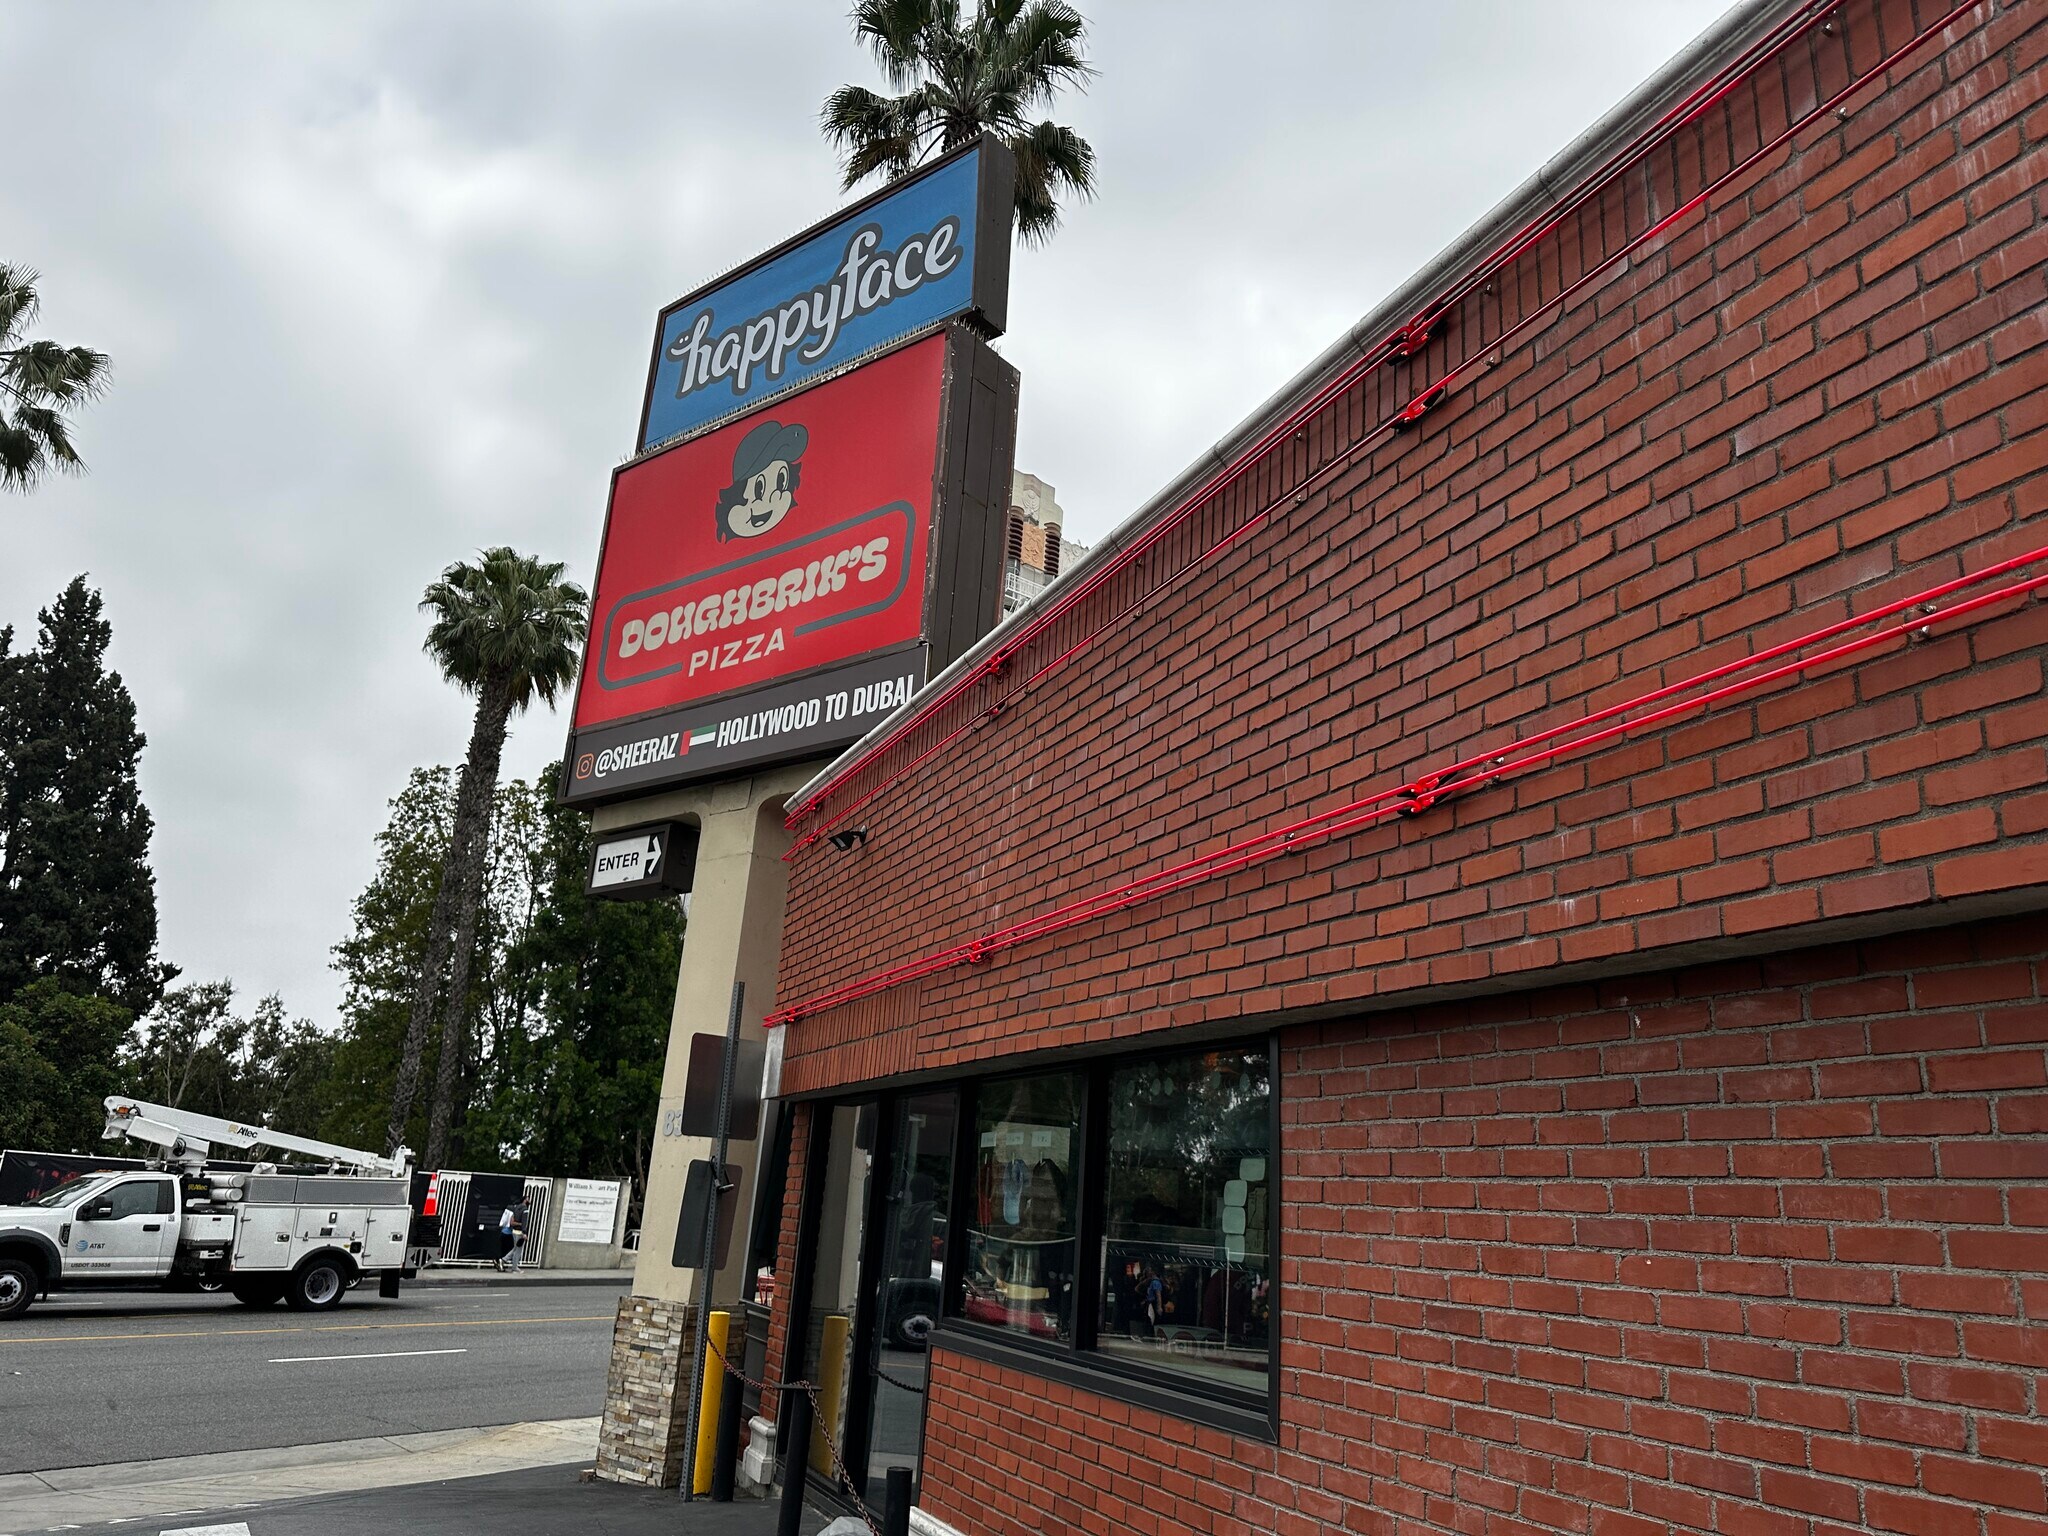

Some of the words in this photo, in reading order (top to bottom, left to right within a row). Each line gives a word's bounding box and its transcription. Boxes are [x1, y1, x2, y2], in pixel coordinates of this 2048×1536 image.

[671, 223, 958, 394] happyface
[618, 536, 890, 658] DOUGHBRIK'S
[688, 627, 785, 677] PIZZA
[594, 732, 680, 778] @SHEERAZ
[716, 698, 821, 748] HOLLYWOOD
[825, 691, 848, 723] TO
[851, 673, 914, 717] DUBAI
[597, 851, 640, 873] ENTER
[236, 1126, 258, 1139] Altec
